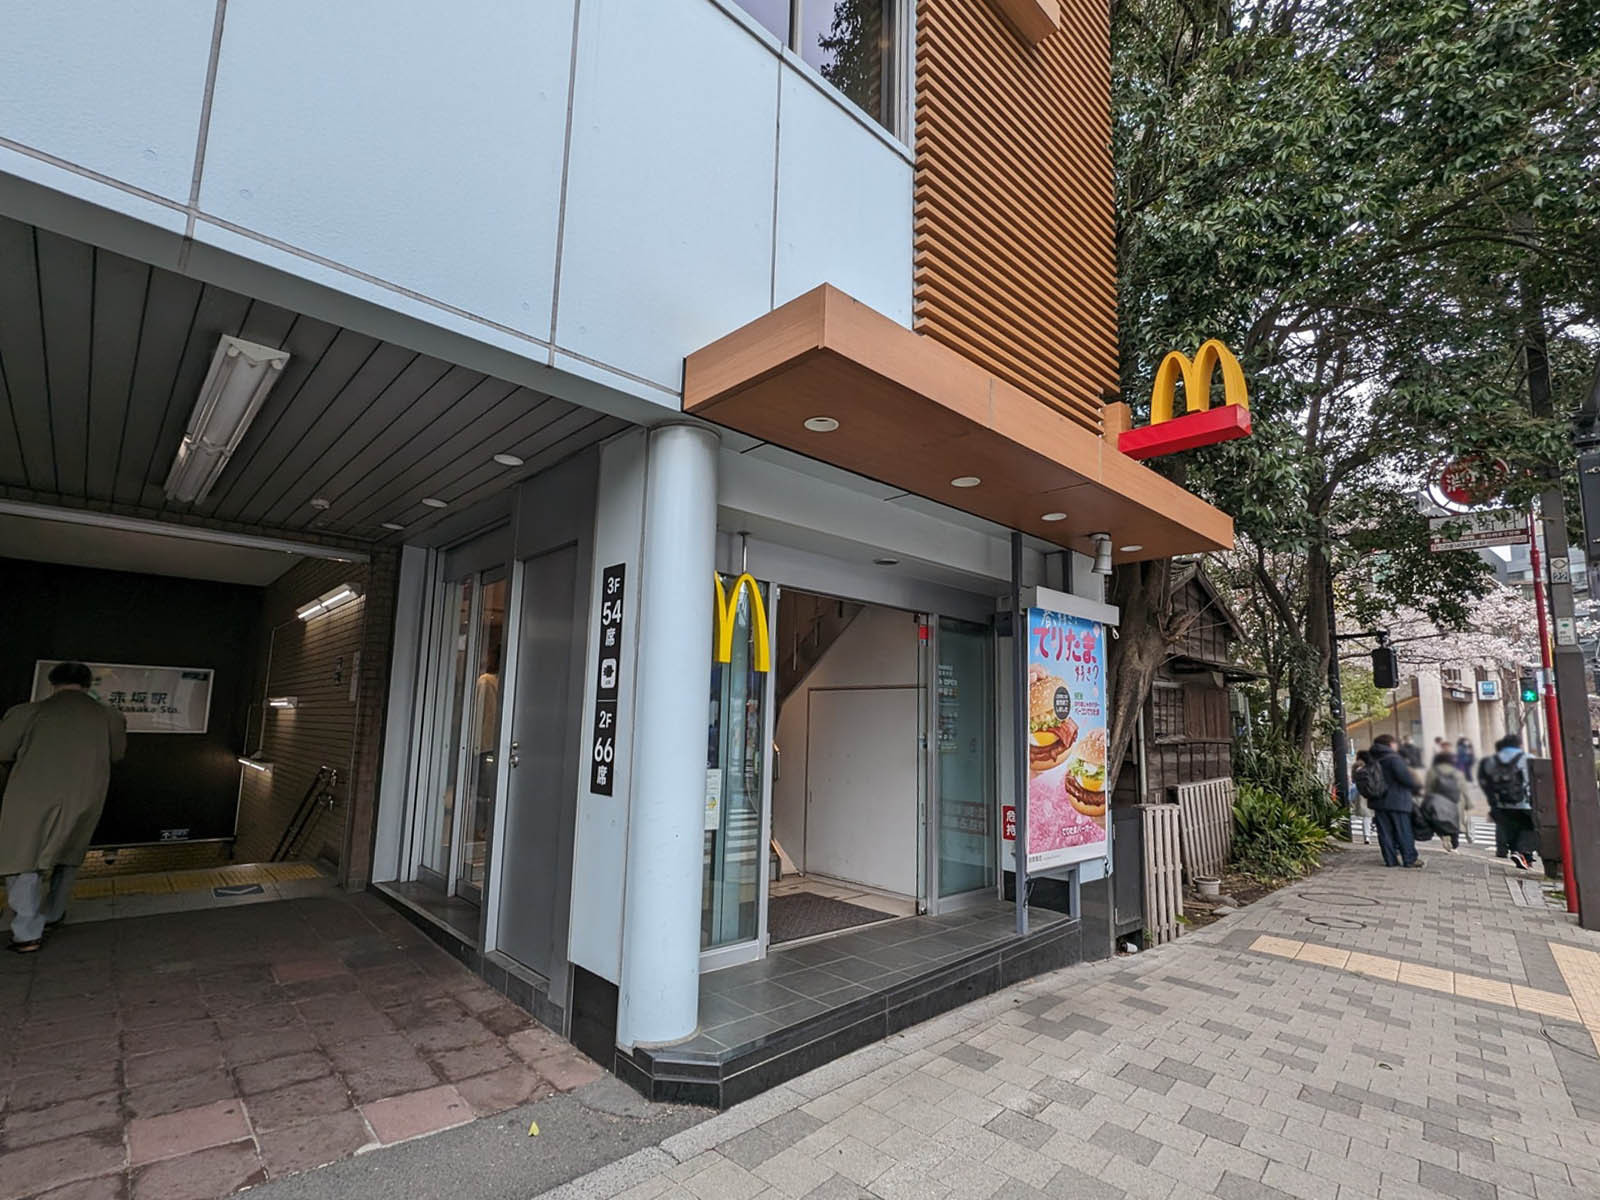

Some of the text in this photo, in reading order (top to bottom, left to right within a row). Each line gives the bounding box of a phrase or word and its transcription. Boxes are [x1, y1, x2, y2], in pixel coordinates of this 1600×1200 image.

[607, 576, 621, 595] 3F
[602, 599, 622, 625] 54
[604, 627, 616, 647] 席
[107, 691, 168, 705] 赤坂駅
[598, 710, 613, 729] 2F
[594, 737, 613, 763] 66
[596, 765, 608, 786] 席
